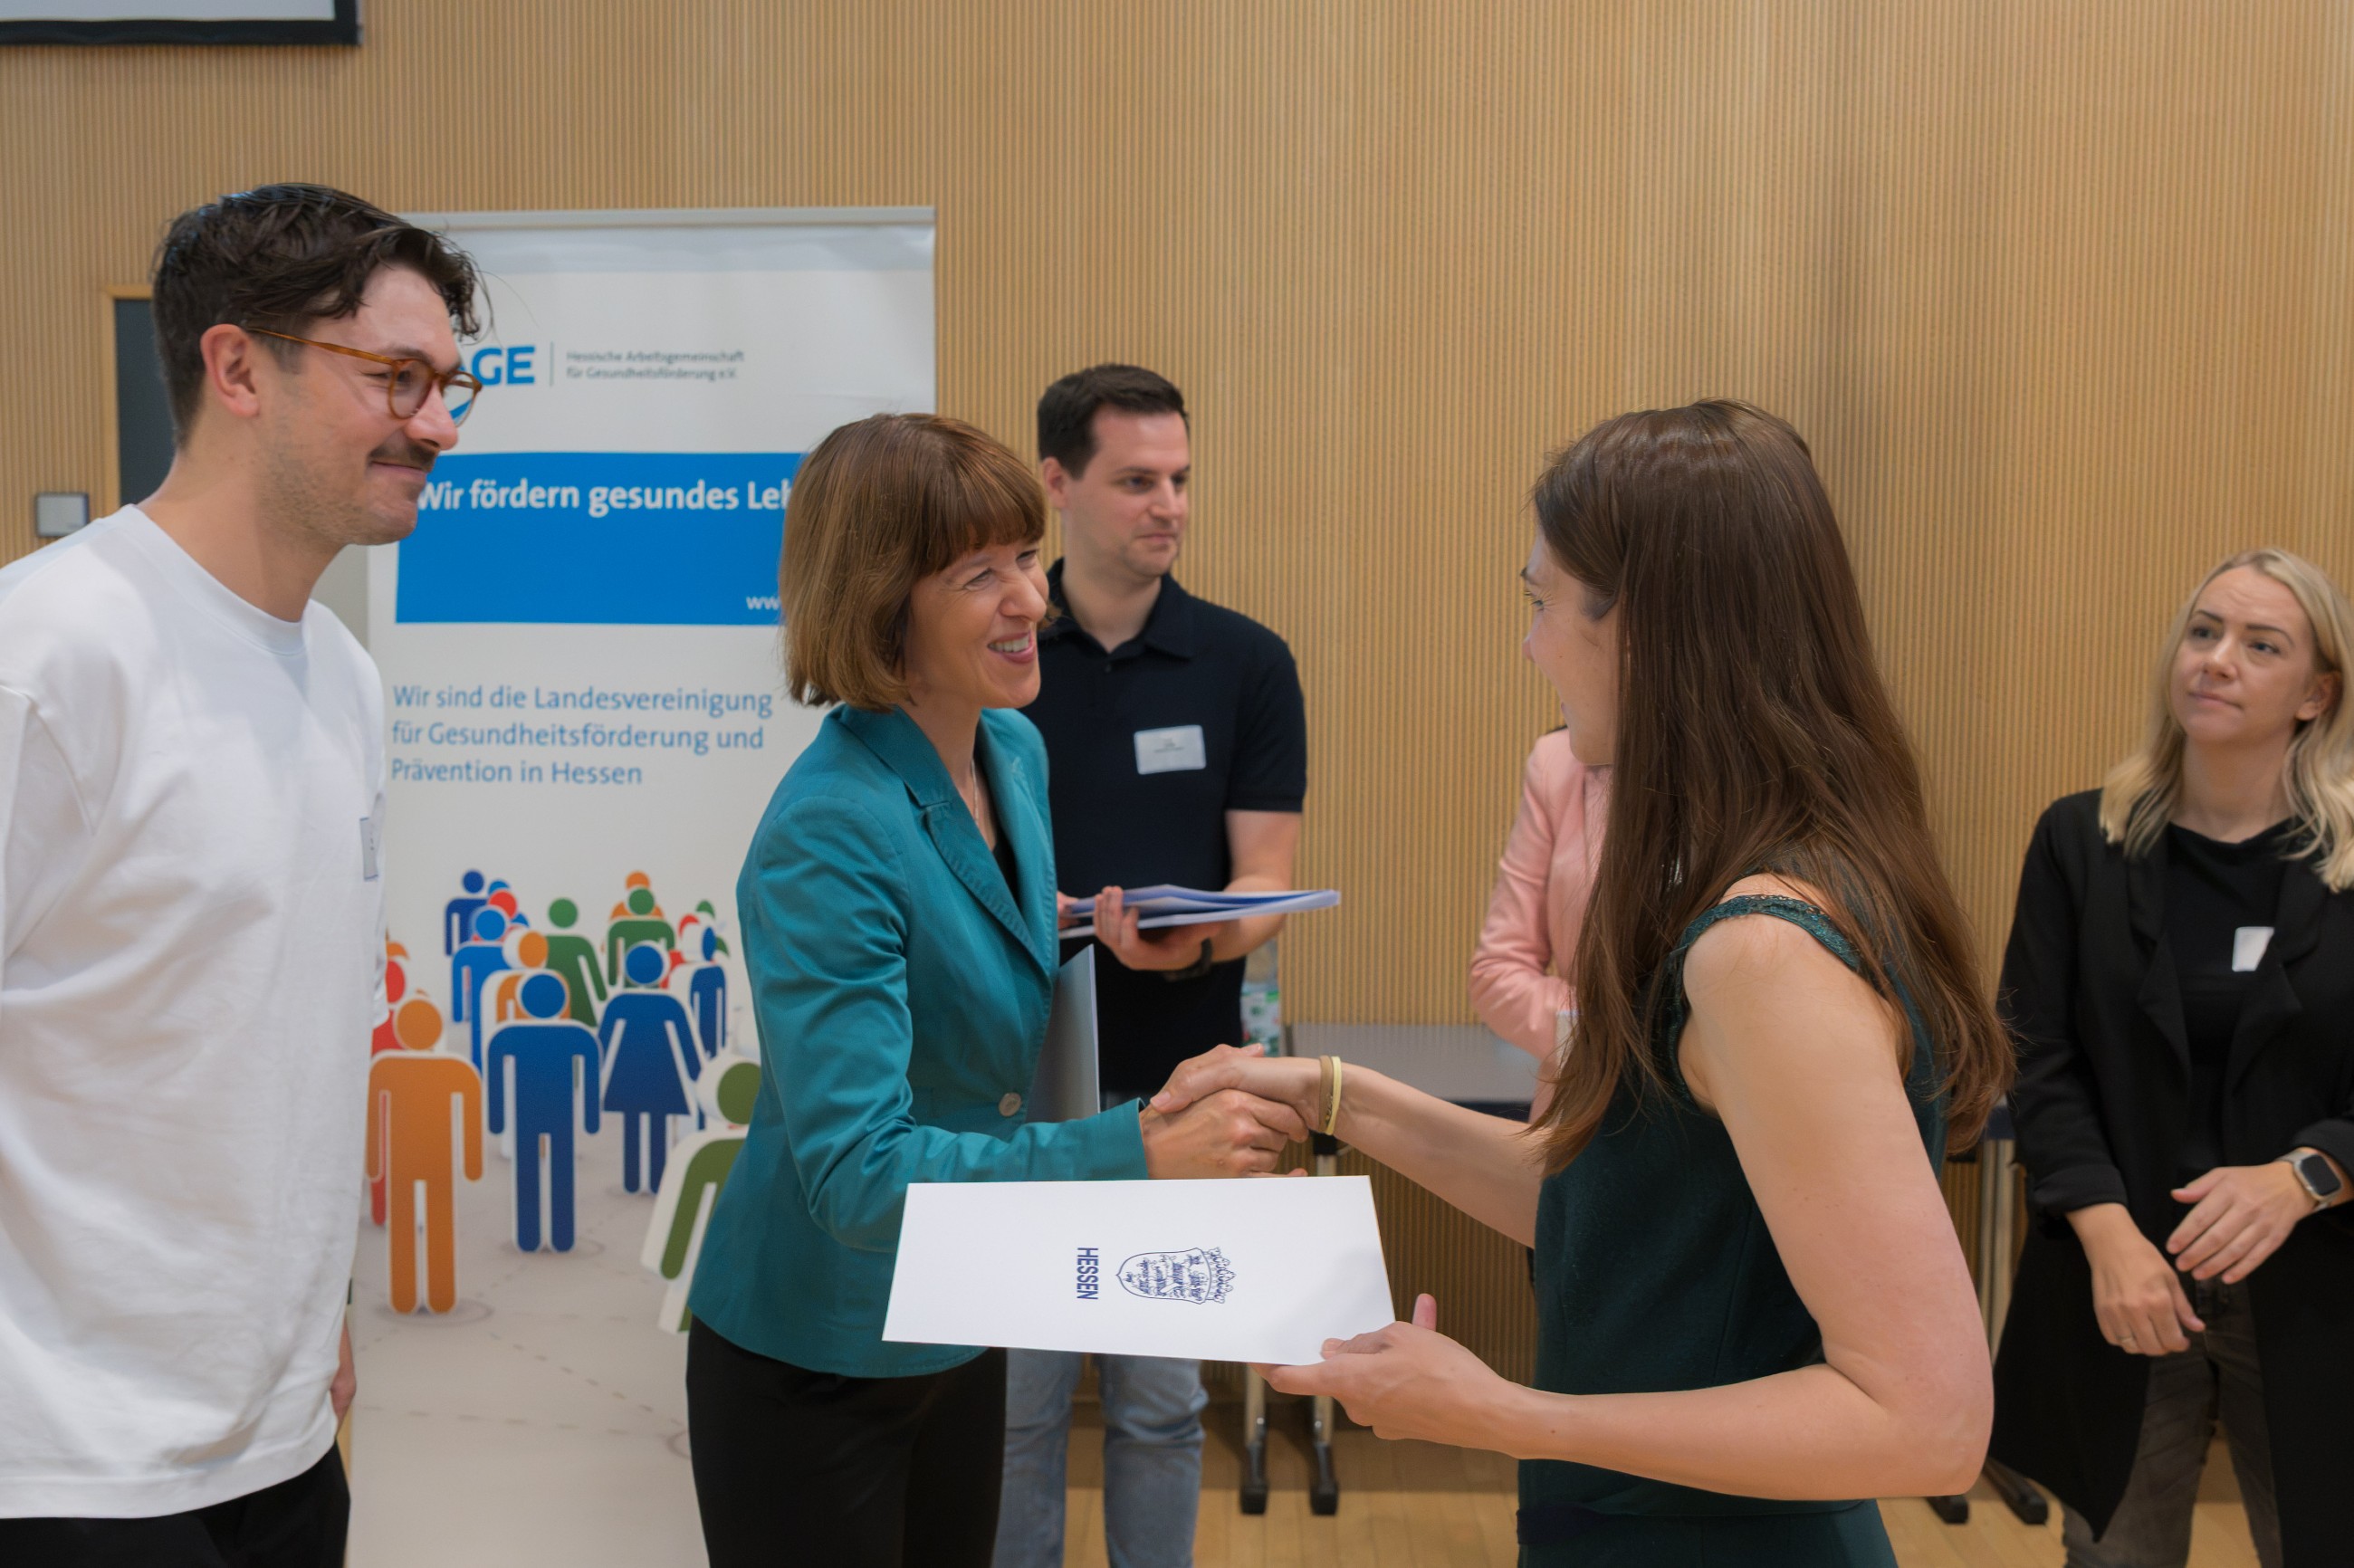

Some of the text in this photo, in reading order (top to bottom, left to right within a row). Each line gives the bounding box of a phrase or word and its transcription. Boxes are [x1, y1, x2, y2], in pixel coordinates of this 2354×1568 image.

[566, 367, 582, 378] für
[586, 368, 717, 382] Gesundheitsförderung
[417, 481, 464, 511] Wir
[469, 477, 579, 510] fördern
[588, 478, 740, 518] gesundes
[393, 684, 773, 720] Wir sind die Landesvereinigung
[392, 720, 764, 756] für Gesundheitsförderung und
[391, 757, 643, 785] Prävention in Hessen
[1077, 1247, 1099, 1300] HESSEN
